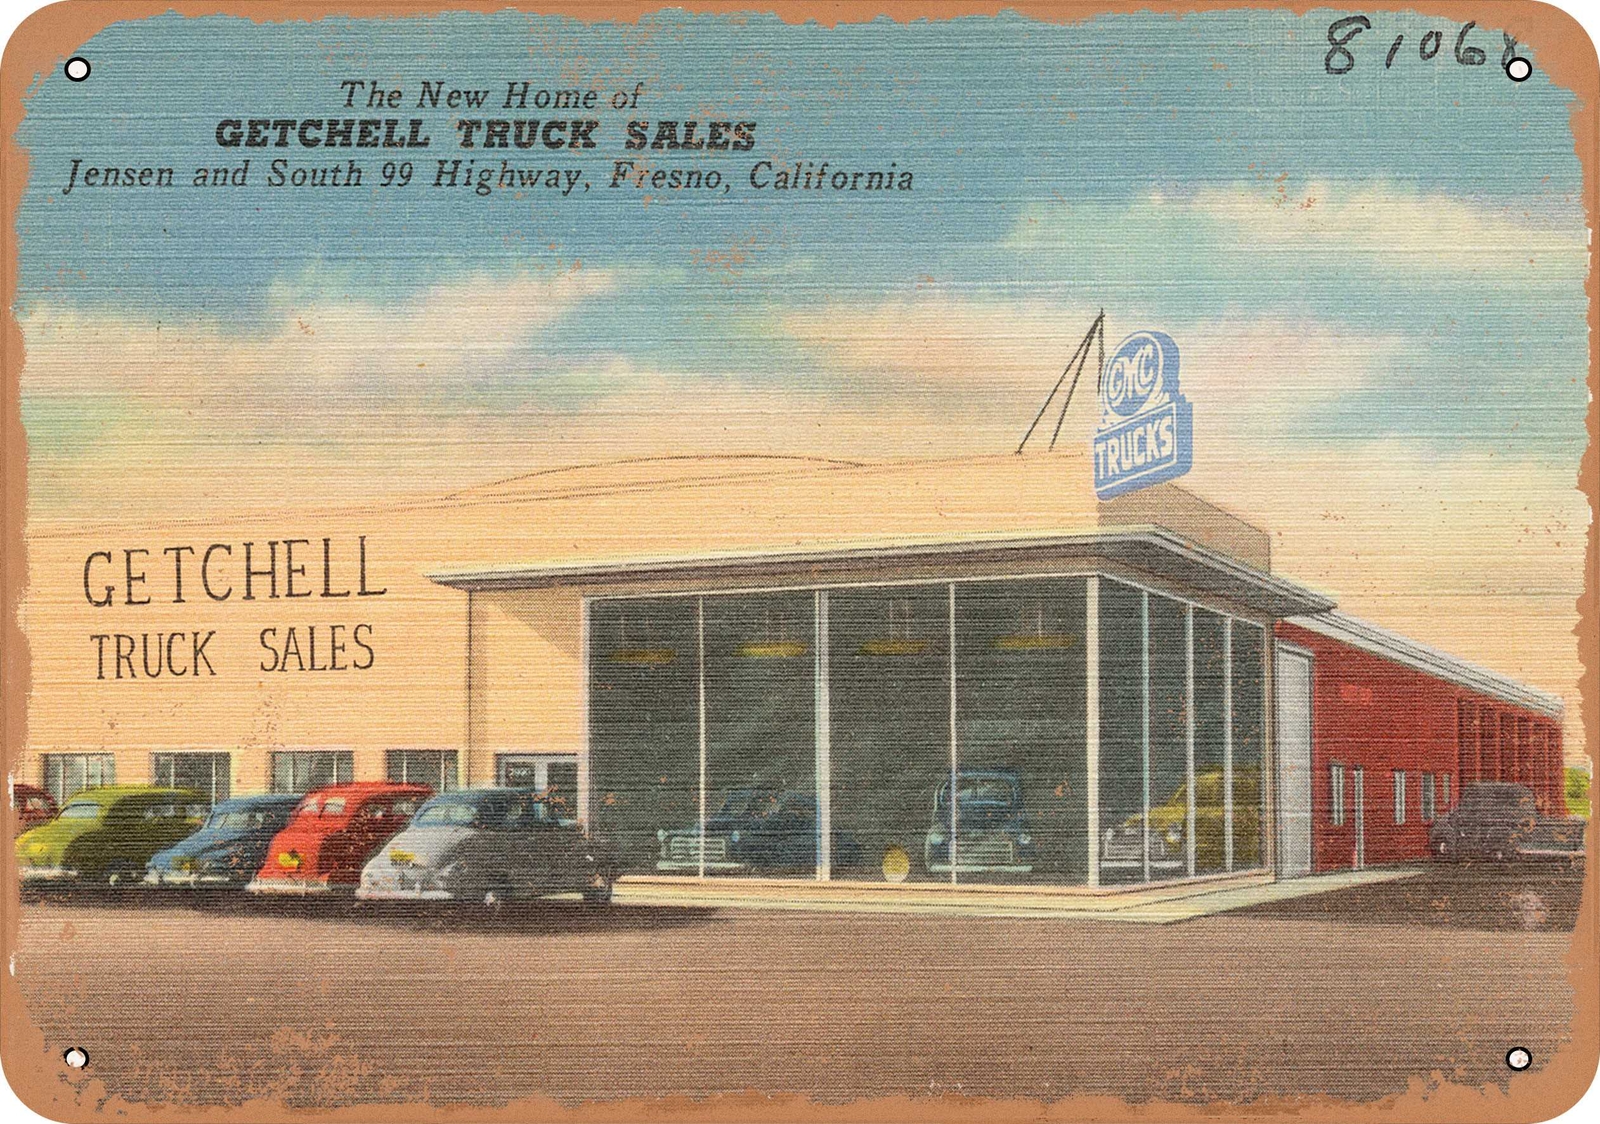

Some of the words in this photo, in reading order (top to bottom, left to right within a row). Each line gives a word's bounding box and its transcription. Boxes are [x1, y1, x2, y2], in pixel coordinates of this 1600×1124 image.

[1095, 416, 1172, 479] TRUCKS
[83, 535, 388, 607] GETCHELL
[90, 630, 216, 680] TRUCK
[259, 624, 374, 672] SALES
